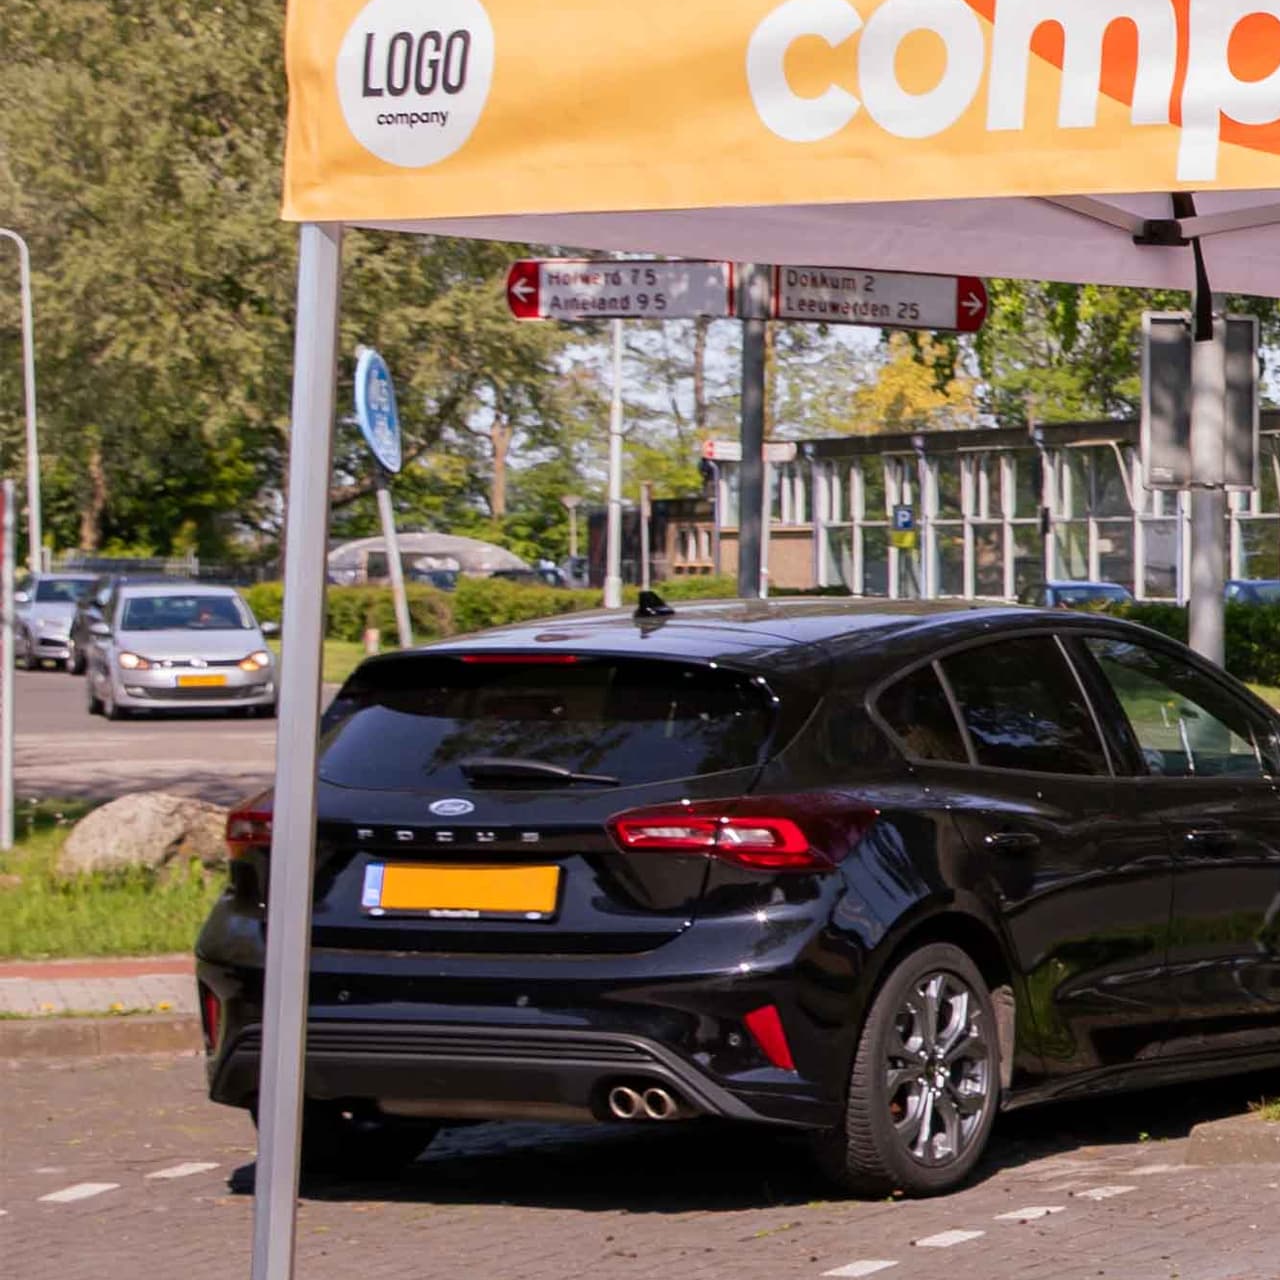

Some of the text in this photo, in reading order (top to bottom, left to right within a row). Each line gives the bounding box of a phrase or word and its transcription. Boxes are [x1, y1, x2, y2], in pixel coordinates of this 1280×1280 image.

[362, 29, 470, 97] LOGO
[377, 111, 448, 129] company
[897, 302, 920, 320] 25
